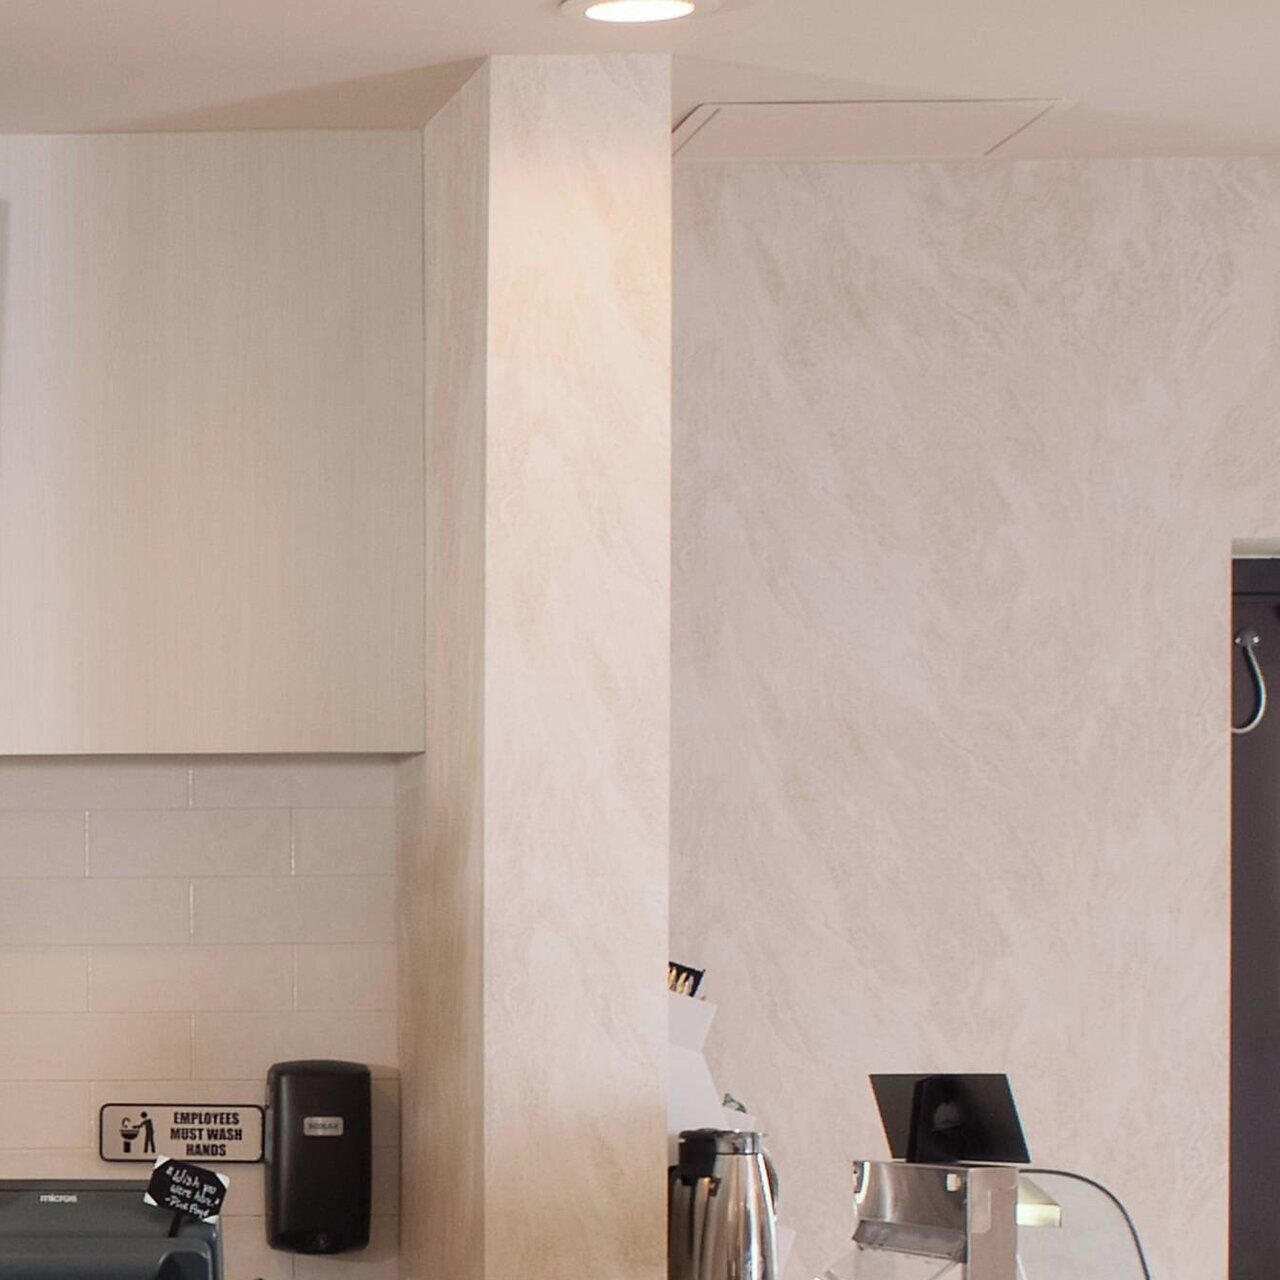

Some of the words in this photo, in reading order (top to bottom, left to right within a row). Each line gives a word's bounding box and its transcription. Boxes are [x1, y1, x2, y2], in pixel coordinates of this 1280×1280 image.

[173, 1112, 240, 1125] EMPLOYEES
[170, 1128, 203, 1141] MUST
[206, 1128, 243, 1141] WASH
[186, 1144, 227, 1157] HANDS
